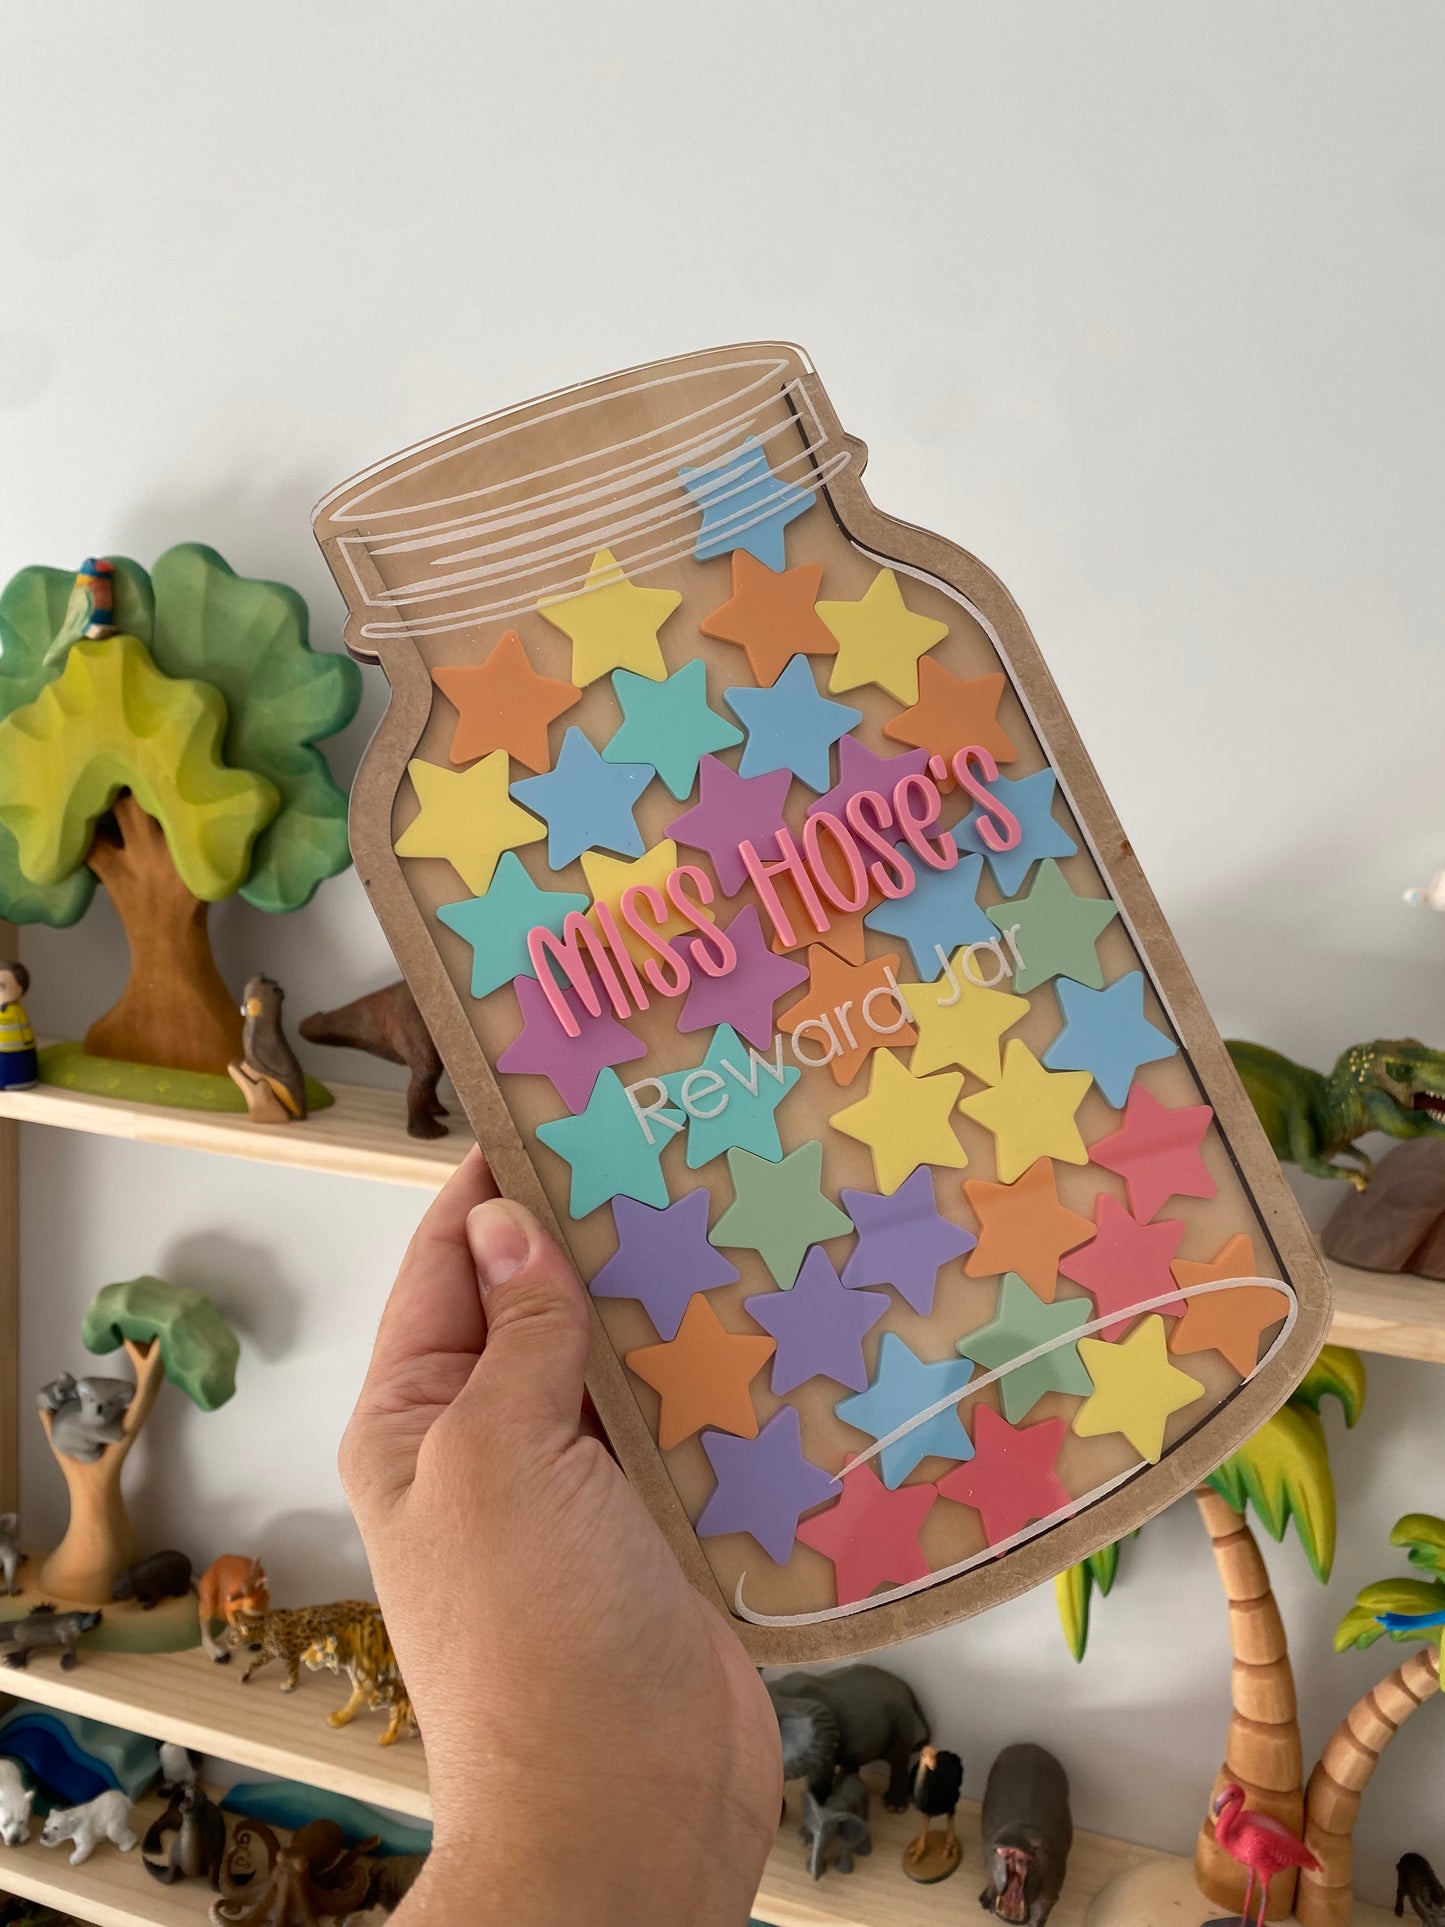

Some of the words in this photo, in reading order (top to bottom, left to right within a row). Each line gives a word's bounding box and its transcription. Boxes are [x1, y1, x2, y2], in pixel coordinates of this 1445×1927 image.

[528, 866, 737, 1037] MISS
[624, 967, 915, 1144] Reward
[934, 923, 1027, 1005] Jar
